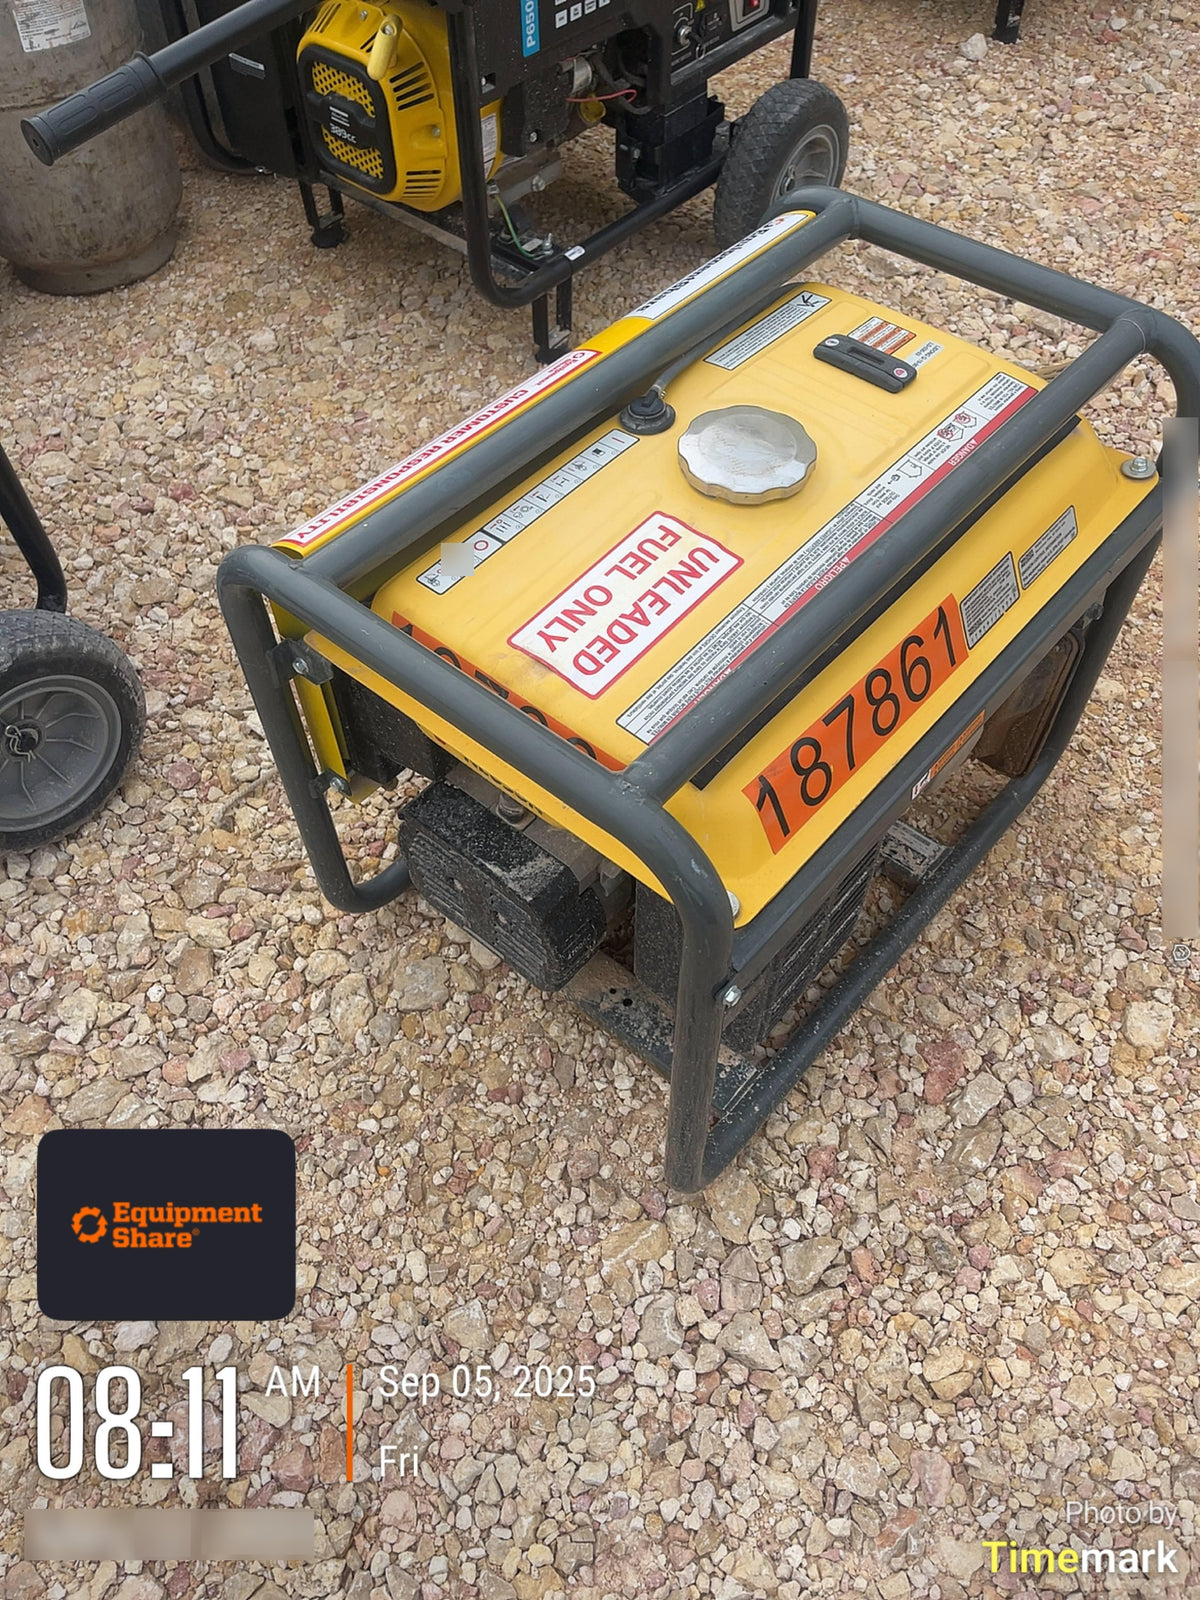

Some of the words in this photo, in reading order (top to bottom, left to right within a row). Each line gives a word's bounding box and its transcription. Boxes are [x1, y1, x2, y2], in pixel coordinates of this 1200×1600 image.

[442, 388, 529, 443] CUSTOMER
[947, 442, 975, 466] DANGER
[298, 443, 443, 540] RESPONSIBILITY
[604, 524, 682, 581] FUEL
[812, 561, 846, 590] PELIGRO
[536, 585, 613, 653] ONLY
[572, 547, 720, 676] UNLEADED
[756, 605, 956, 837] 187861
